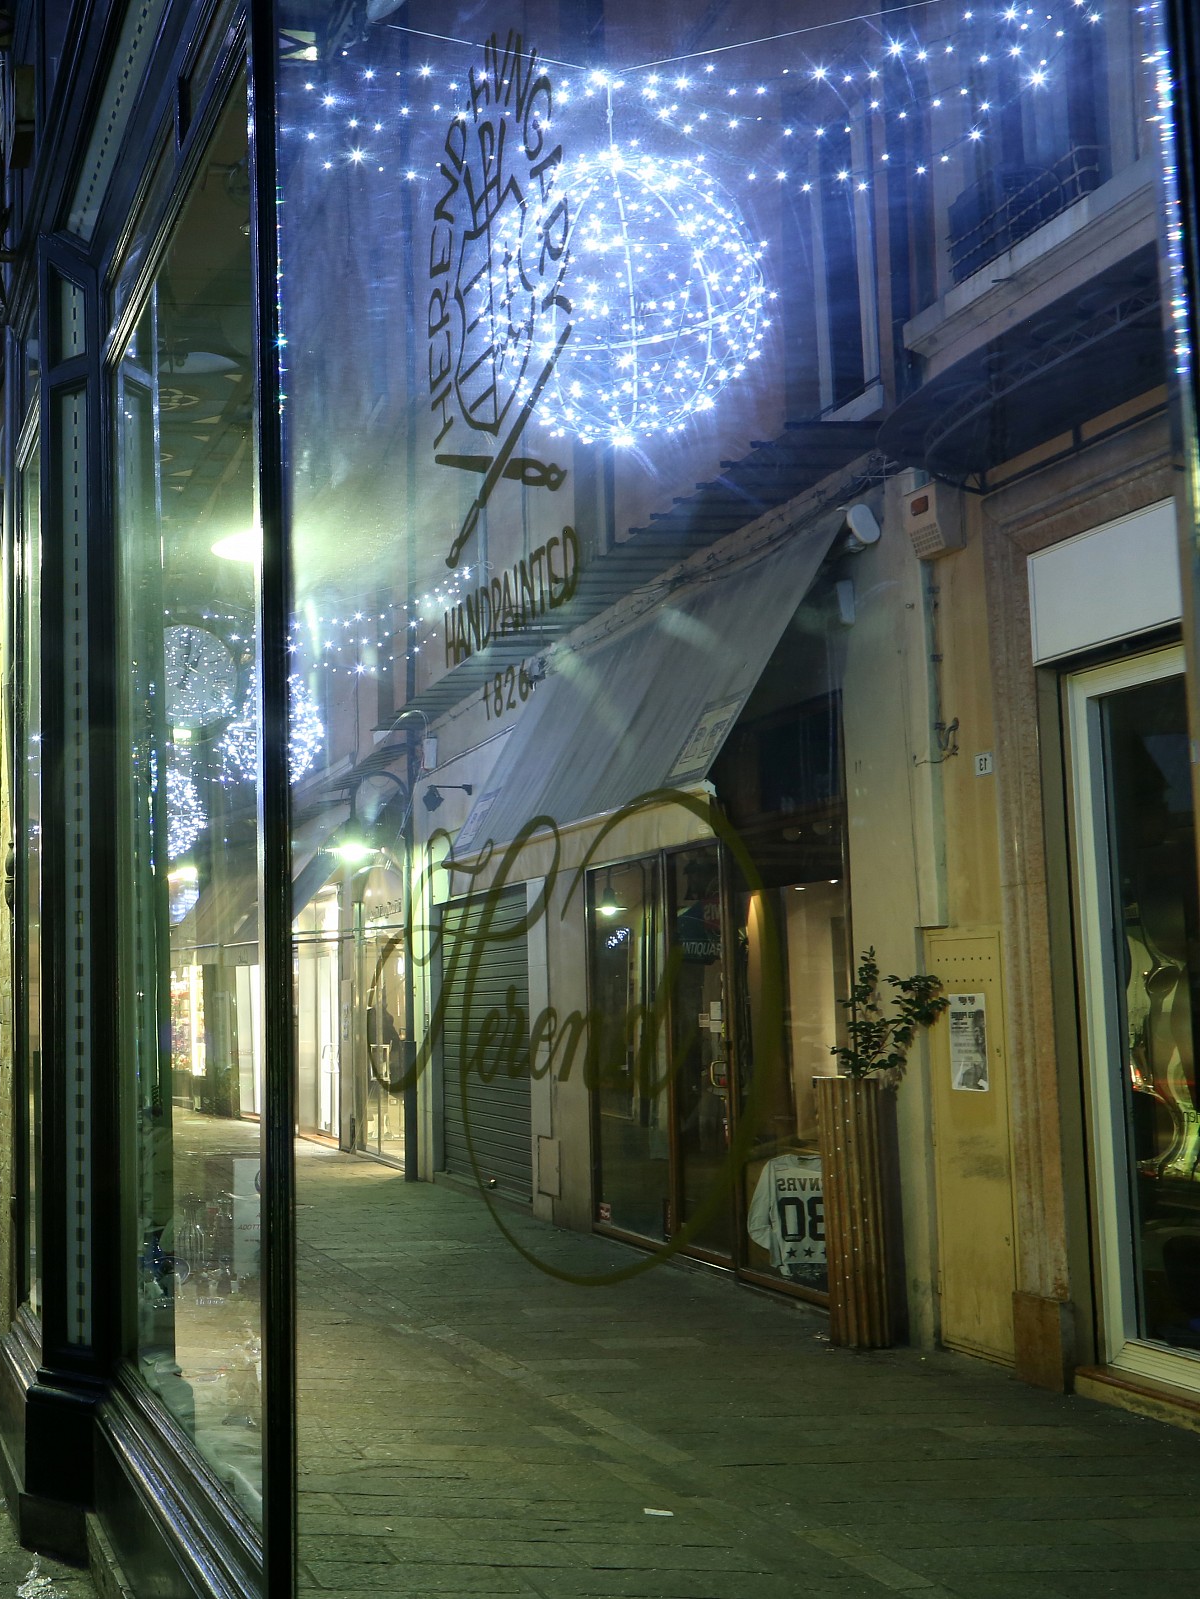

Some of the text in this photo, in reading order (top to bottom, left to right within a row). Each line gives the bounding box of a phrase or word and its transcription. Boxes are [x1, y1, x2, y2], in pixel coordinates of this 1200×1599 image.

[428, 115, 468, 450] HEREND
[443, 525, 579, 669] HANDPAINTED
[483, 659, 530, 721] 1826
